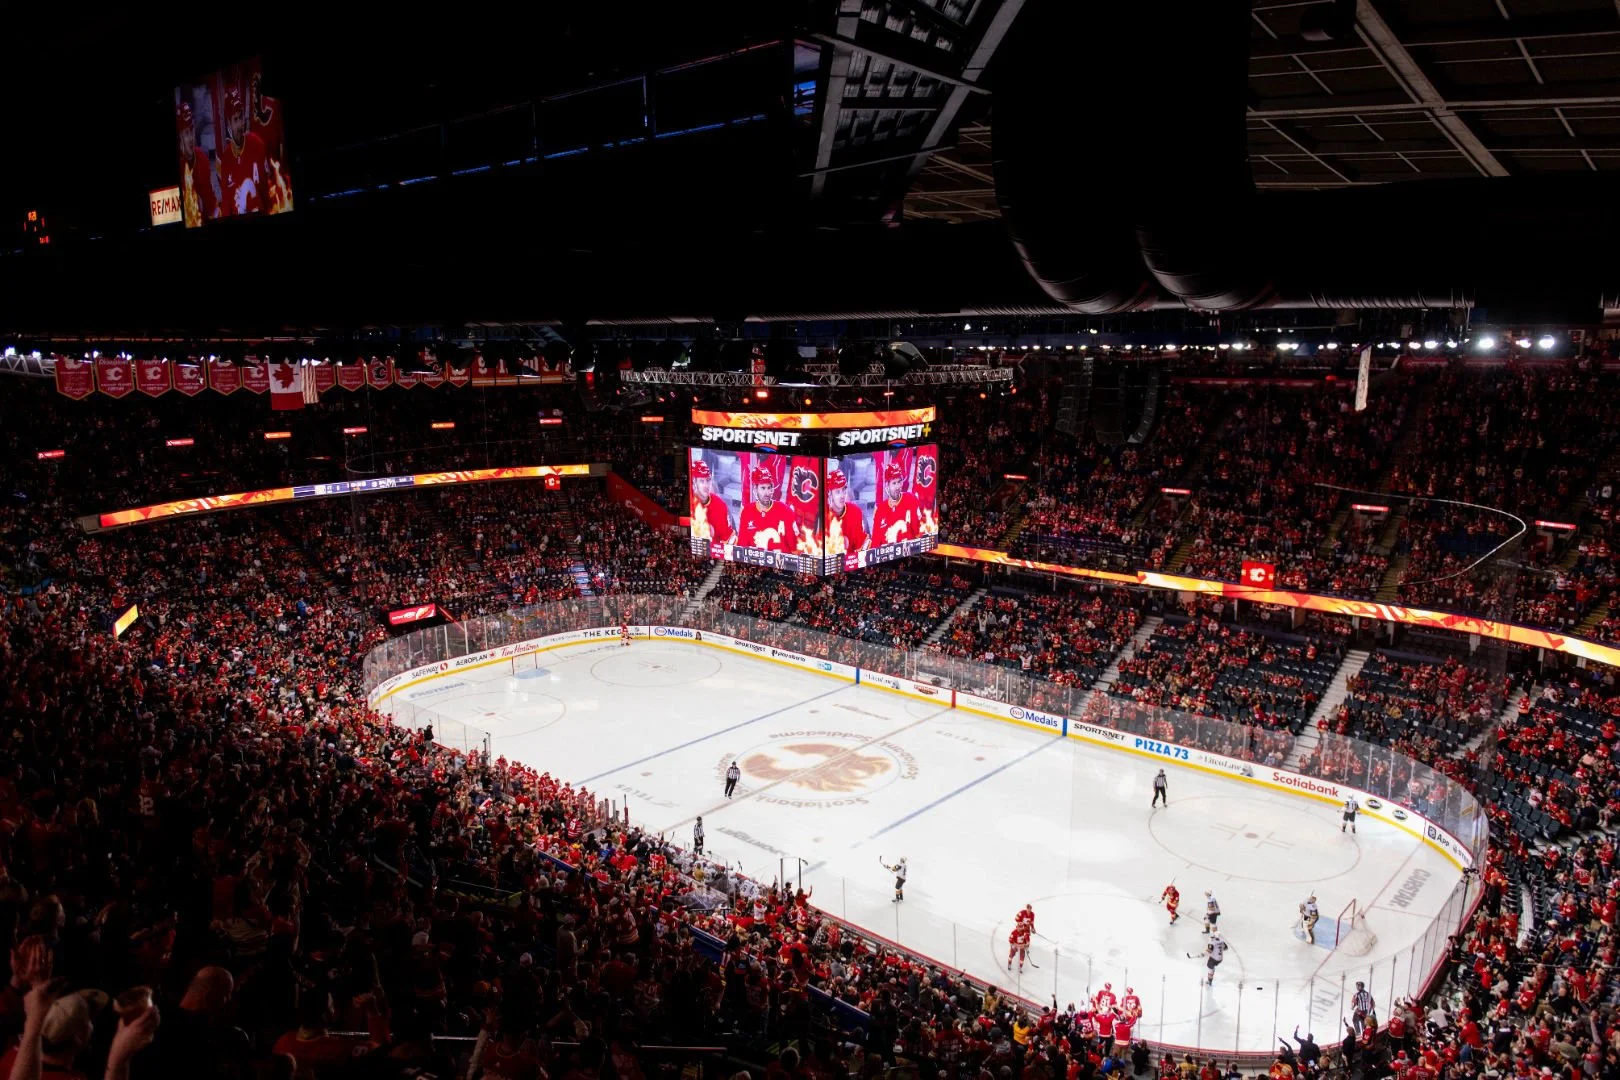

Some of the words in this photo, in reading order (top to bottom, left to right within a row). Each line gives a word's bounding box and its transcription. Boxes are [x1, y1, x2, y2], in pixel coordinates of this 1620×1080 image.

[151, 196, 181, 216] RE/MAX
[701, 426, 801, 447] SPORTSNET
[583, 630, 602, 638] THE
[667, 628, 694, 638] Medals
[455, 653, 488, 667] AEROPLAN
[411, 665, 439, 679] SAFEWAY
[1025, 711, 1059, 727] Medals
[1073, 722, 1126, 741] SPORTSNET
[1135, 738, 1171, 756] PIZZA
[1173, 746, 1190, 760] 73
[1272, 771, 1340, 797] Scotiabank
